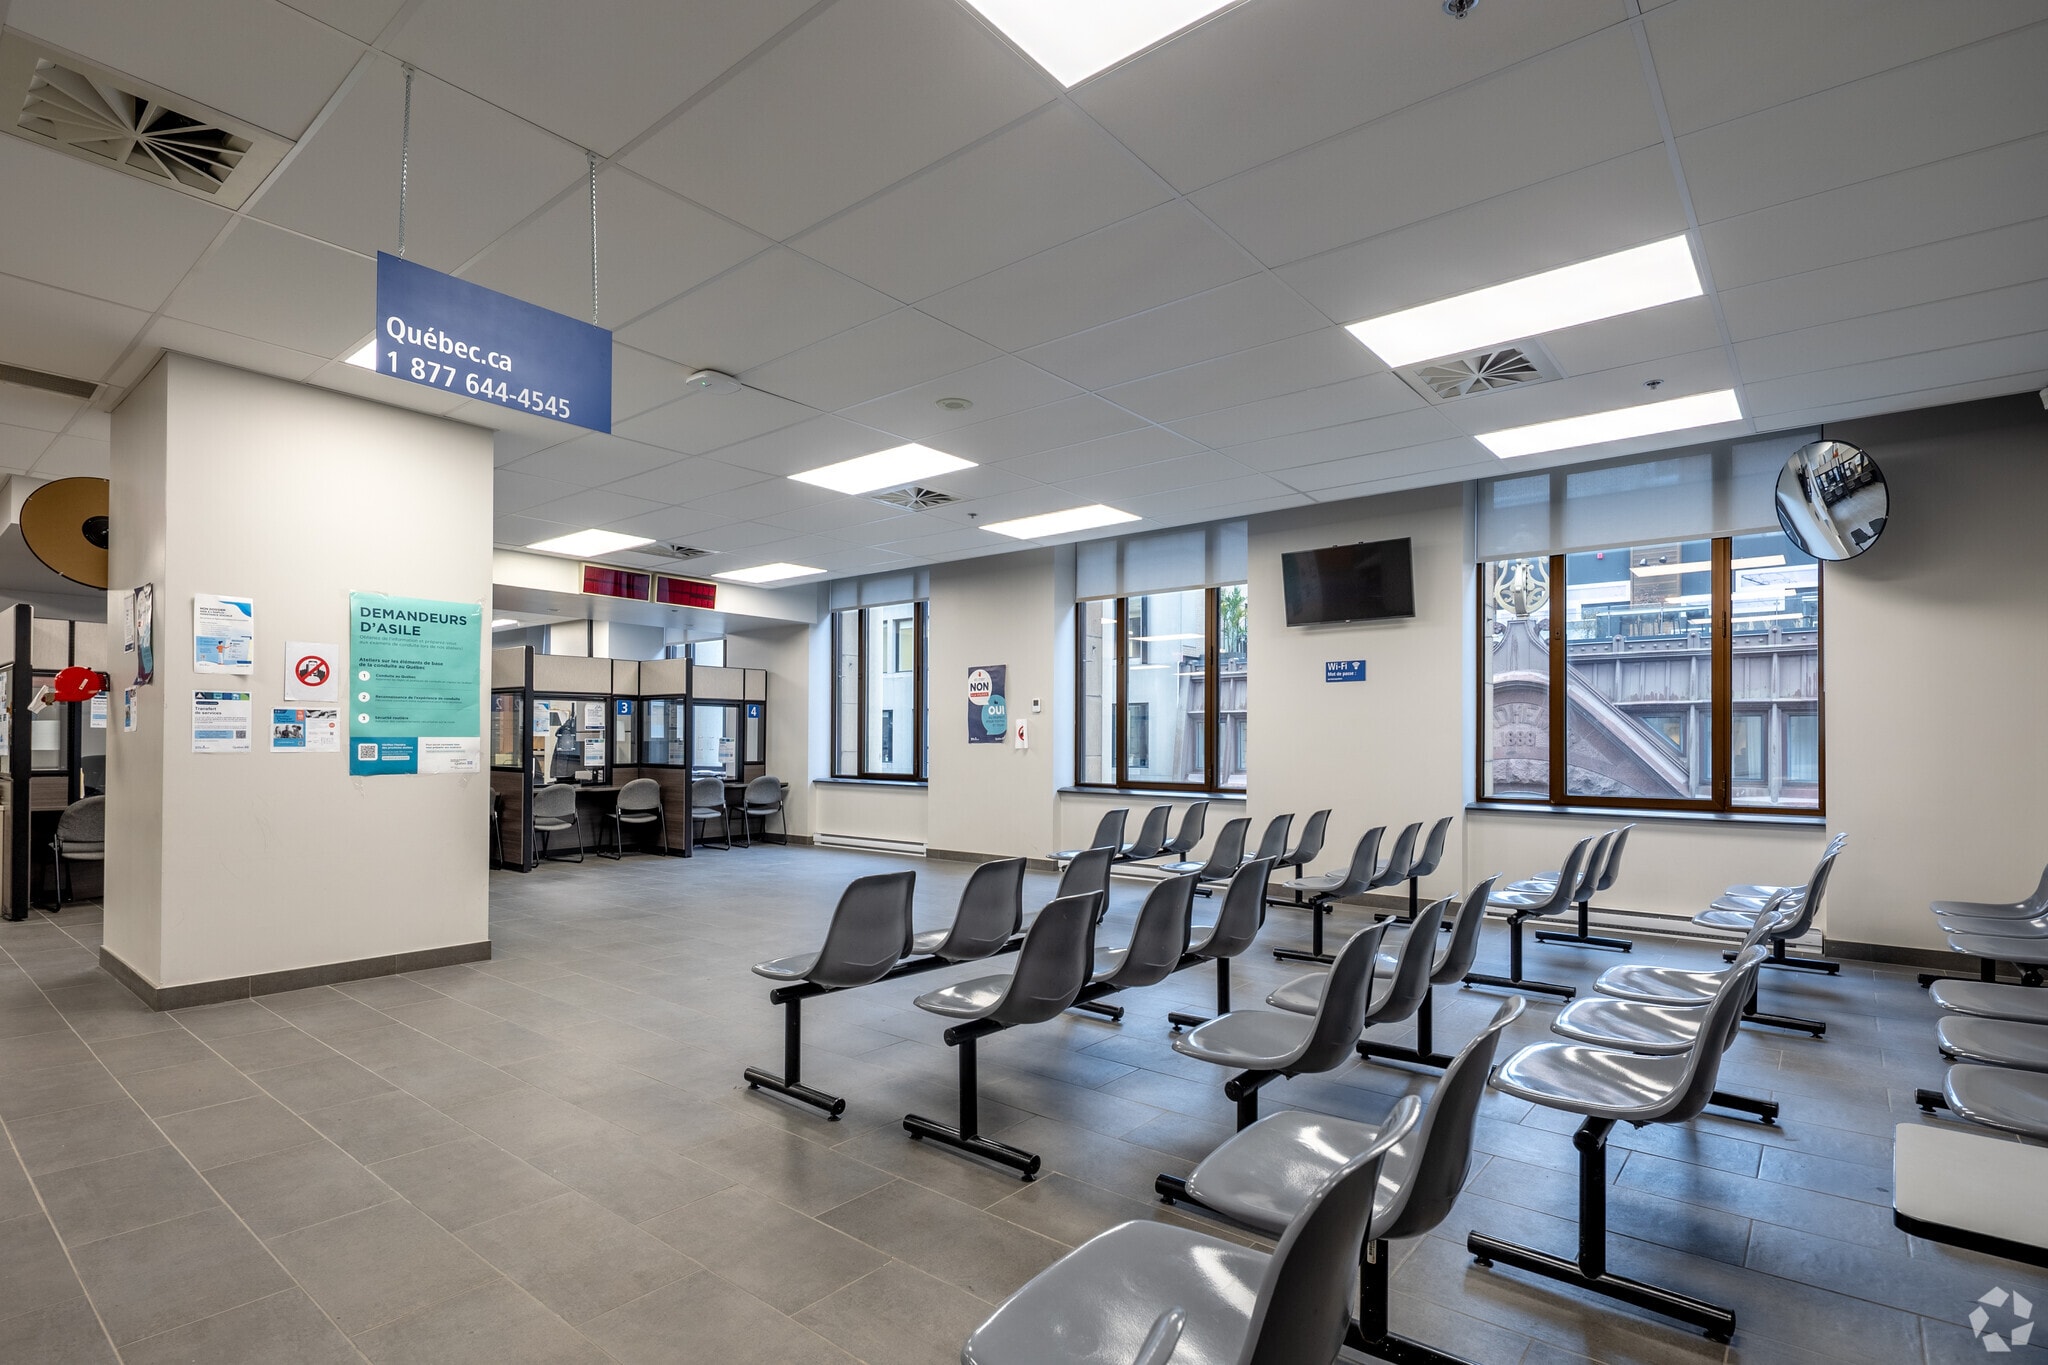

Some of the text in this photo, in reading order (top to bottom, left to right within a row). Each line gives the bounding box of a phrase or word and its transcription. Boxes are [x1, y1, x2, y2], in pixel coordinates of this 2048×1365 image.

[386, 316, 512, 372] Québec.ca
[387, 351, 571, 419] 1 877 644-4545
[360, 606, 468, 626] DEMANDEURS
[1327, 662, 1348, 671] Wi-Fi
[970, 682, 989, 692] NON
[621, 702, 628, 713] 3
[750, 706, 757, 716] 4
[988, 705, 1005, 716] OUI
